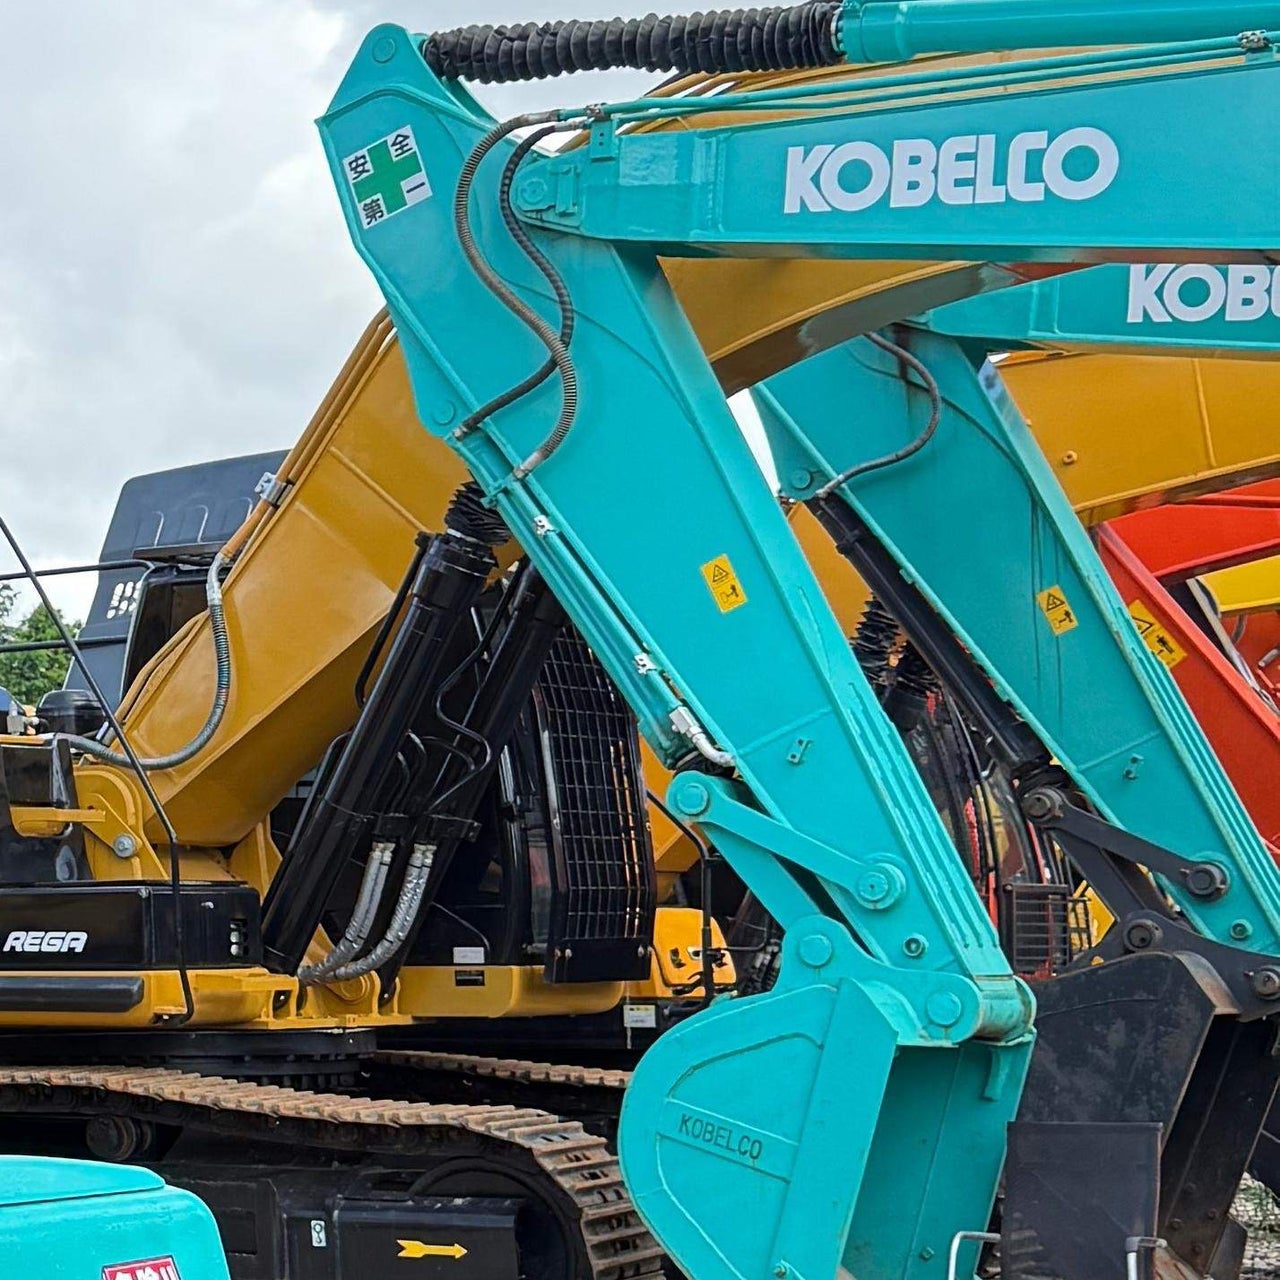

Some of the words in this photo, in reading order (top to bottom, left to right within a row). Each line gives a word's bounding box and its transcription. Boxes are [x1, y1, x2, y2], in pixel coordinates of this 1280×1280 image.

[784, 127, 1119, 214] KOBELCO
[1127, 263, 1280, 323] KOB
[3, 931, 88, 952] REGA
[678, 1113, 763, 1160] KOBELCO
